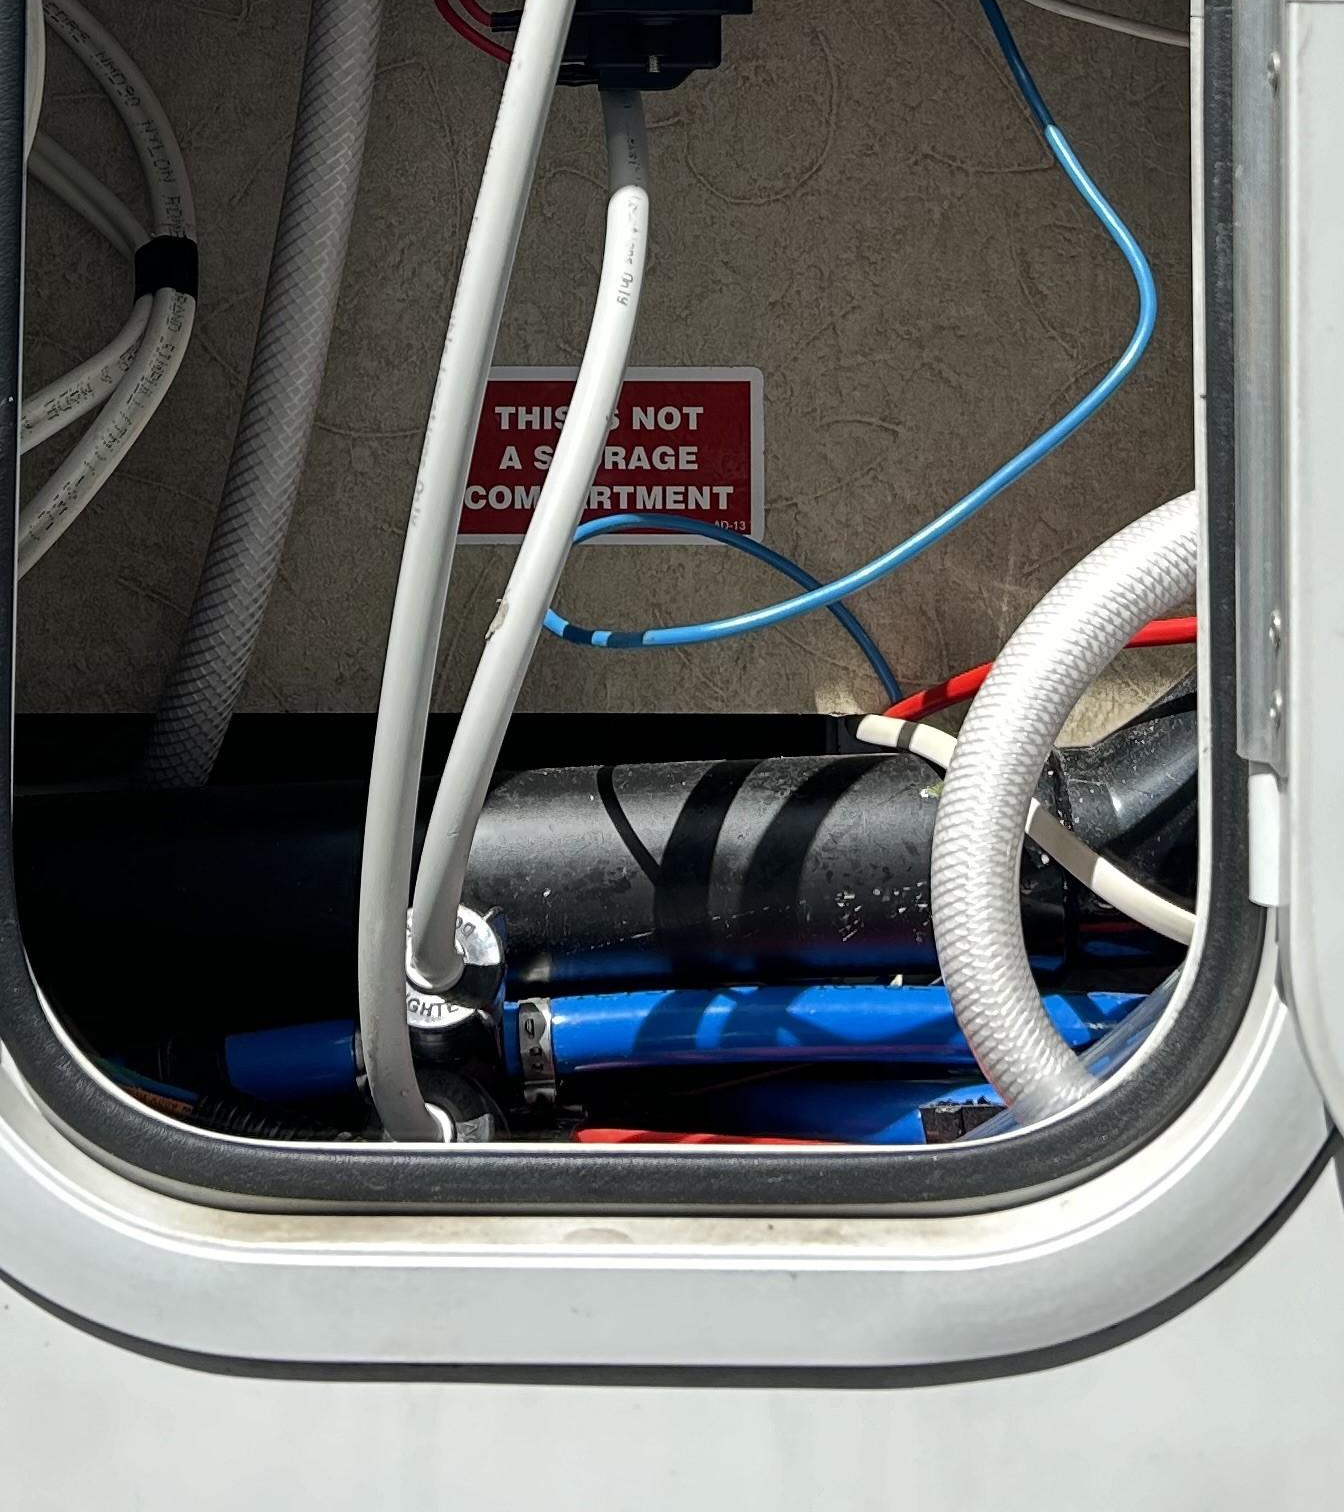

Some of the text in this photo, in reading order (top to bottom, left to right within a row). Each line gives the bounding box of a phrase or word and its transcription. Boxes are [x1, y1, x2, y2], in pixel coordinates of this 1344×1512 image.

[617, 272, 633, 307] Only
[632, 406, 704, 430] NOT
[499, 445, 699, 470] A SRAGE
[464, 485, 734, 510] COMRTMENT
